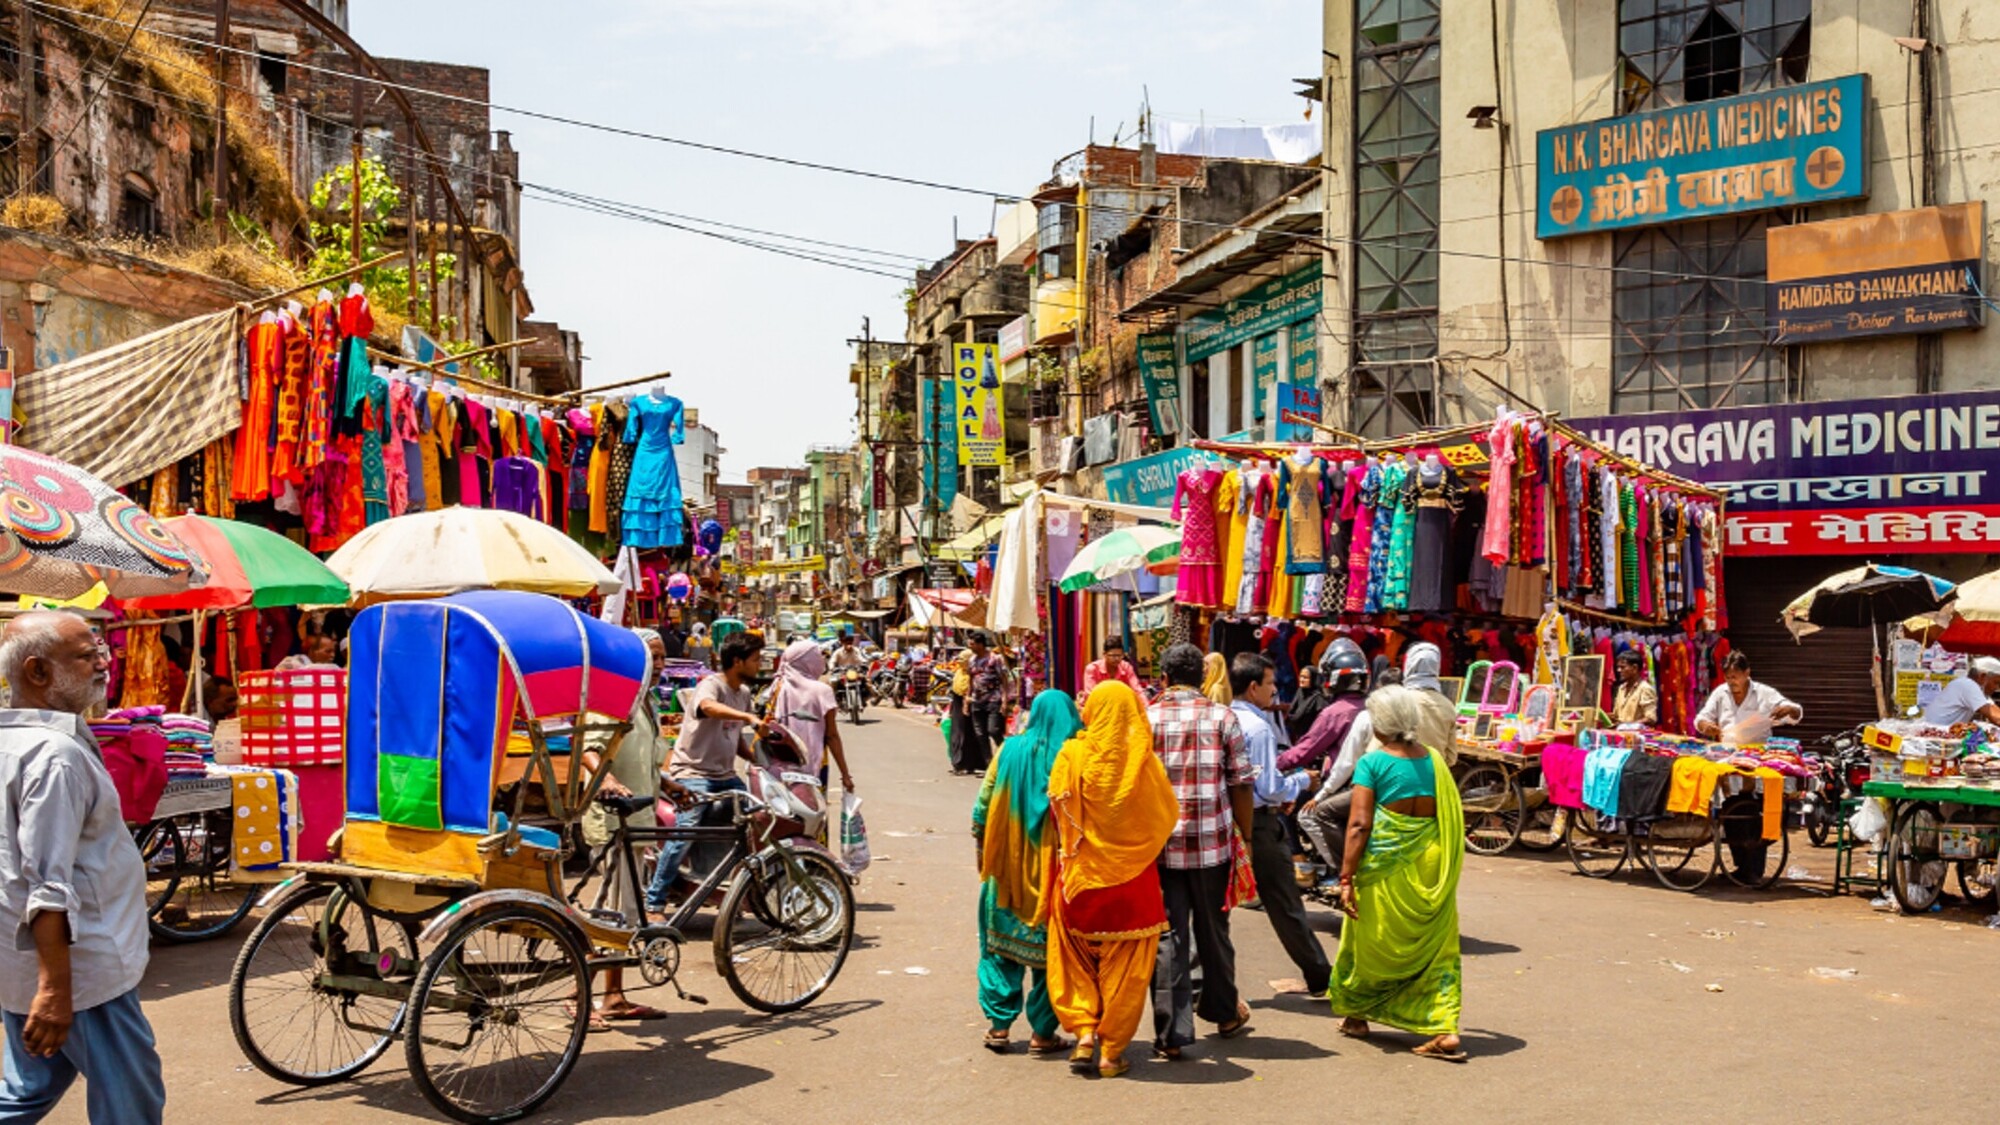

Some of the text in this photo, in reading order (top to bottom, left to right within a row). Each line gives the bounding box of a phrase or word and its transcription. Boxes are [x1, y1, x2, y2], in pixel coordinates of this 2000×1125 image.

[1554, 87, 1842, 175] N.K. BHARGAVA MEDICINES
[1589, 156, 1797, 223] अंग्रेजी दवाखाना
[1778, 268, 1969, 311] HAMDARD DAWAKHANA
[960, 348, 978, 439] ROYAL
[1292, 388, 1321, 408] TAJ
[1576, 418, 1775, 470] HARGAVA
